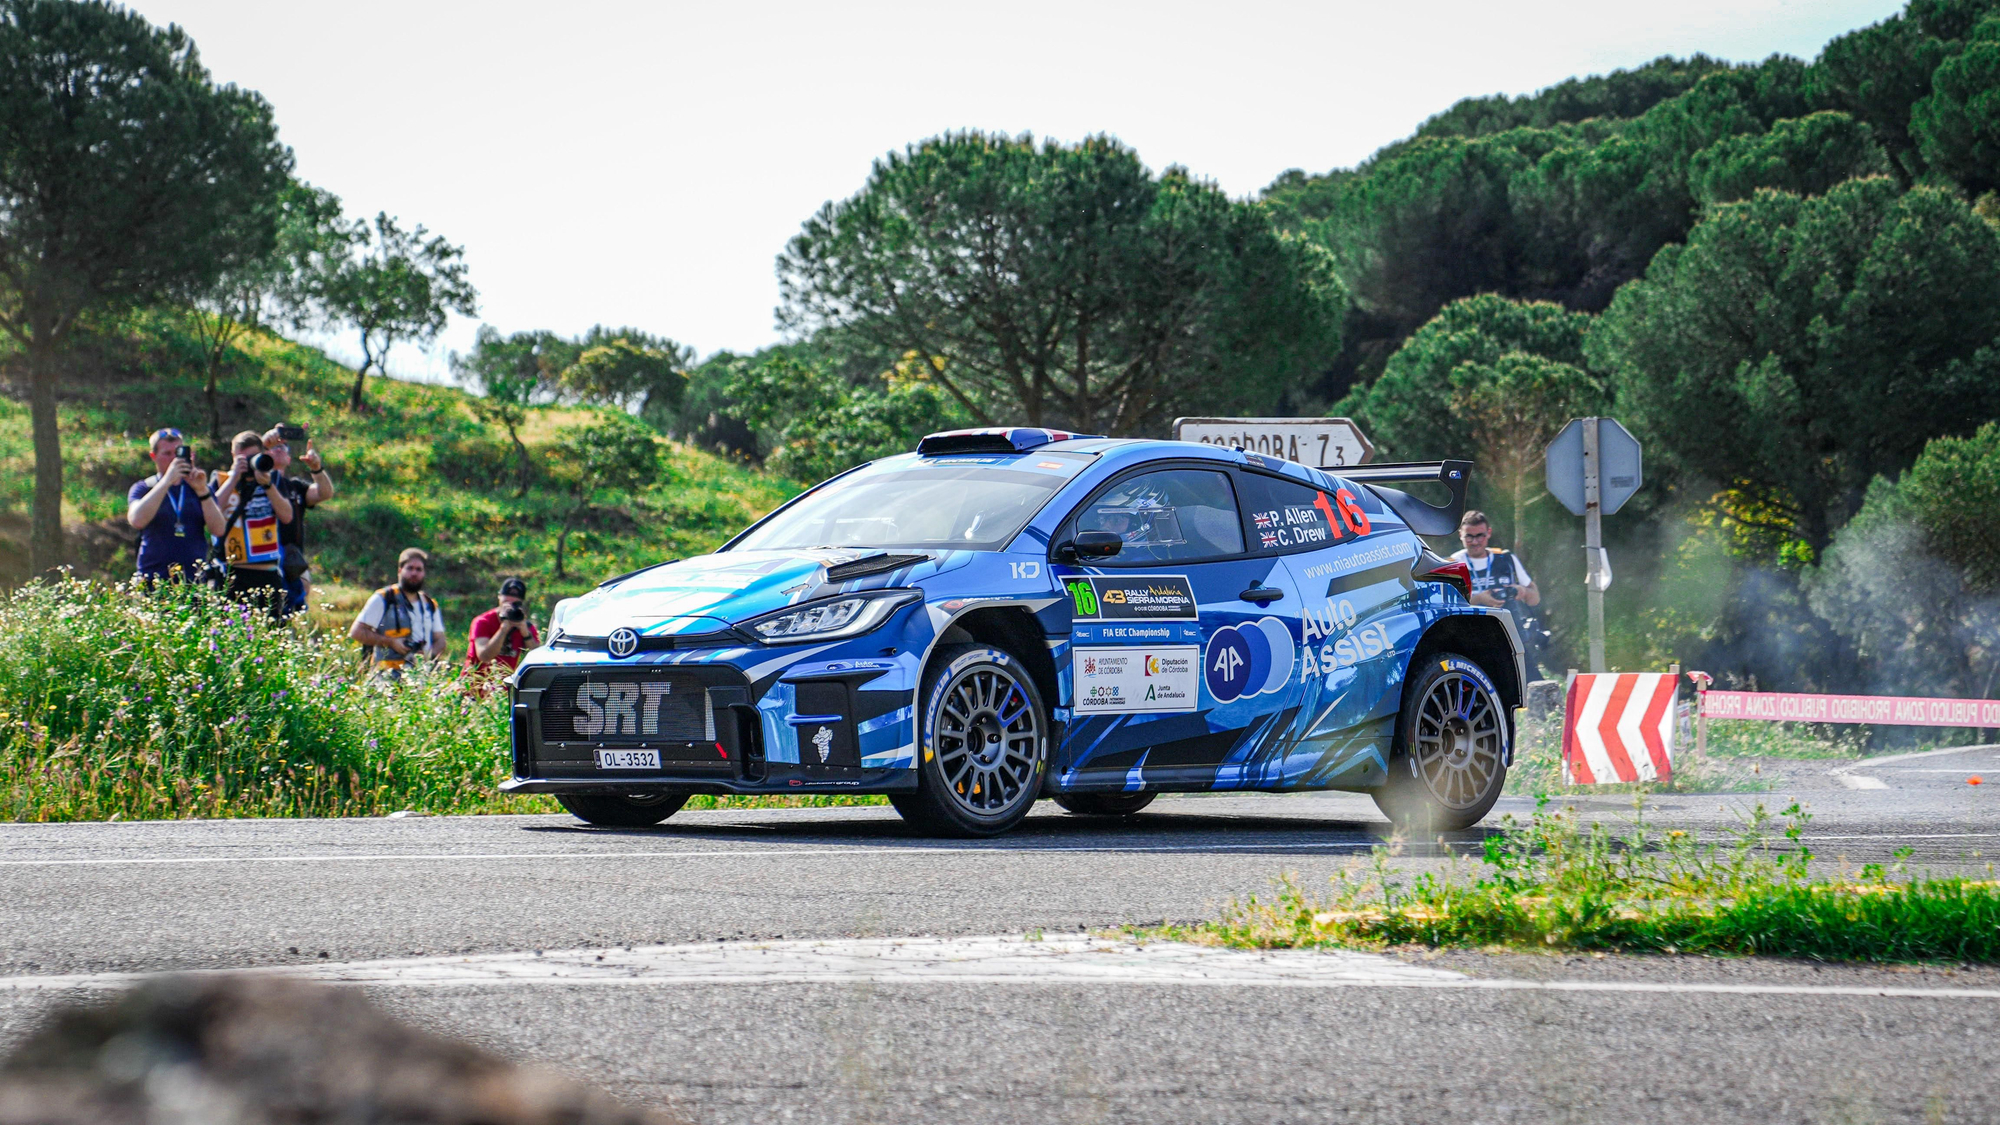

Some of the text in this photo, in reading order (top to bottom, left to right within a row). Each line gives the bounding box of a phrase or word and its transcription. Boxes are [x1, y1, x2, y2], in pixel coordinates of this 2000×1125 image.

[1200, 432, 1299, 463] DOBA
[1269, 507, 1317, 527] P. Allen
[1313, 488, 1371, 539] 16
[1278, 527, 1326, 546] C. Drew
[1303, 541, 1412, 579] www.niautoassist.com
[1067, 582, 1097, 616] 16
[1103, 589, 1126, 604] 43
[1124, 589, 1149, 597] RALLY
[1103, 627, 1170, 638] FIA ERC Championship
[1303, 597, 1356, 645] Auto
[1213, 646, 1244, 682] AA
[1300, 621, 1394, 684] Assist
[1456, 661, 1492, 690] MICHELIN
[572, 682, 671, 735] SRT
